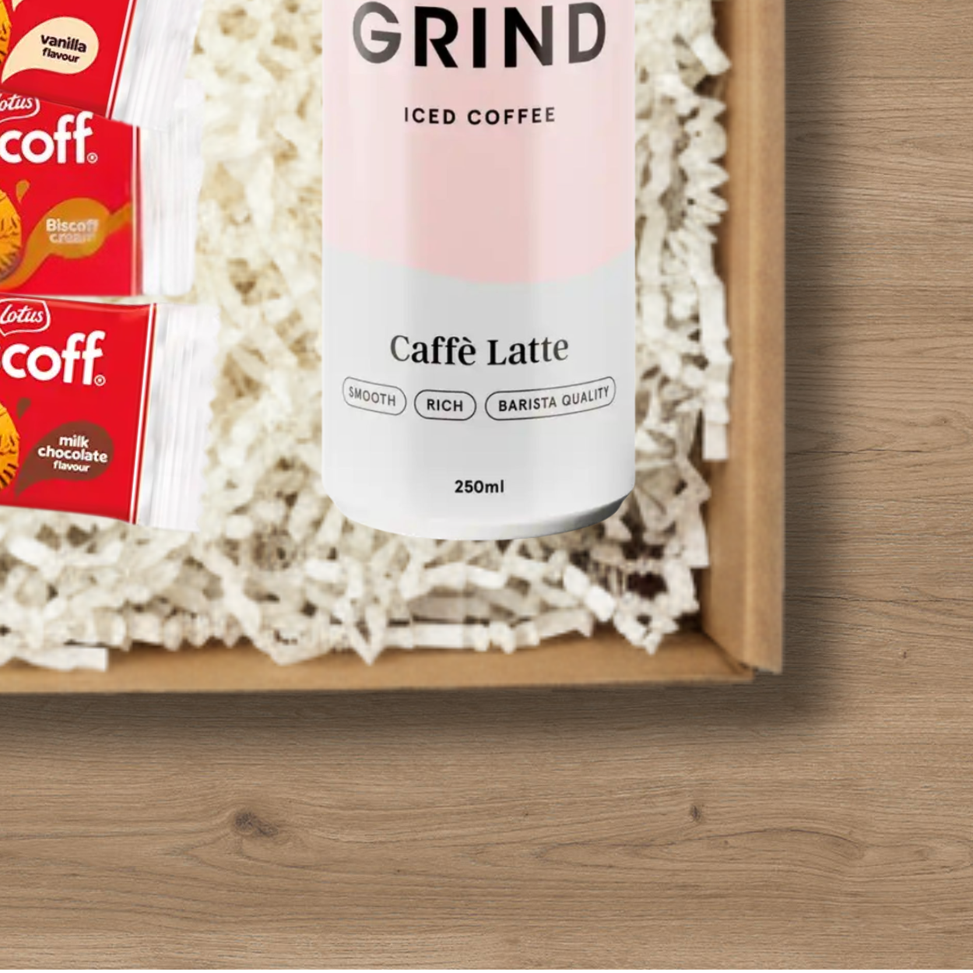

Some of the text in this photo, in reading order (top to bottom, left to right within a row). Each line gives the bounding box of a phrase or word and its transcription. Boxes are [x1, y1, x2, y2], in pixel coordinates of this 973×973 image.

[40, 34, 87, 53] vanilla
[352, 1, 606, 68] GRIND
[42, 47, 80, 63] flavour
[403, 107, 555, 125] ICED COFFEE
[0, 303, 44, 324] Lotus
[390, 335, 568, 366] Caffè Latte
[348, 386, 397, 407] SMOOTH
[426, 399, 463, 411] RICH
[498, 385, 610, 412] BARISTA QUALITY
[59, 435, 89, 448] milk
[38, 446, 108, 463] chocolate
[53, 459, 90, 473] flavour
[454, 480, 504, 493] 250ml
